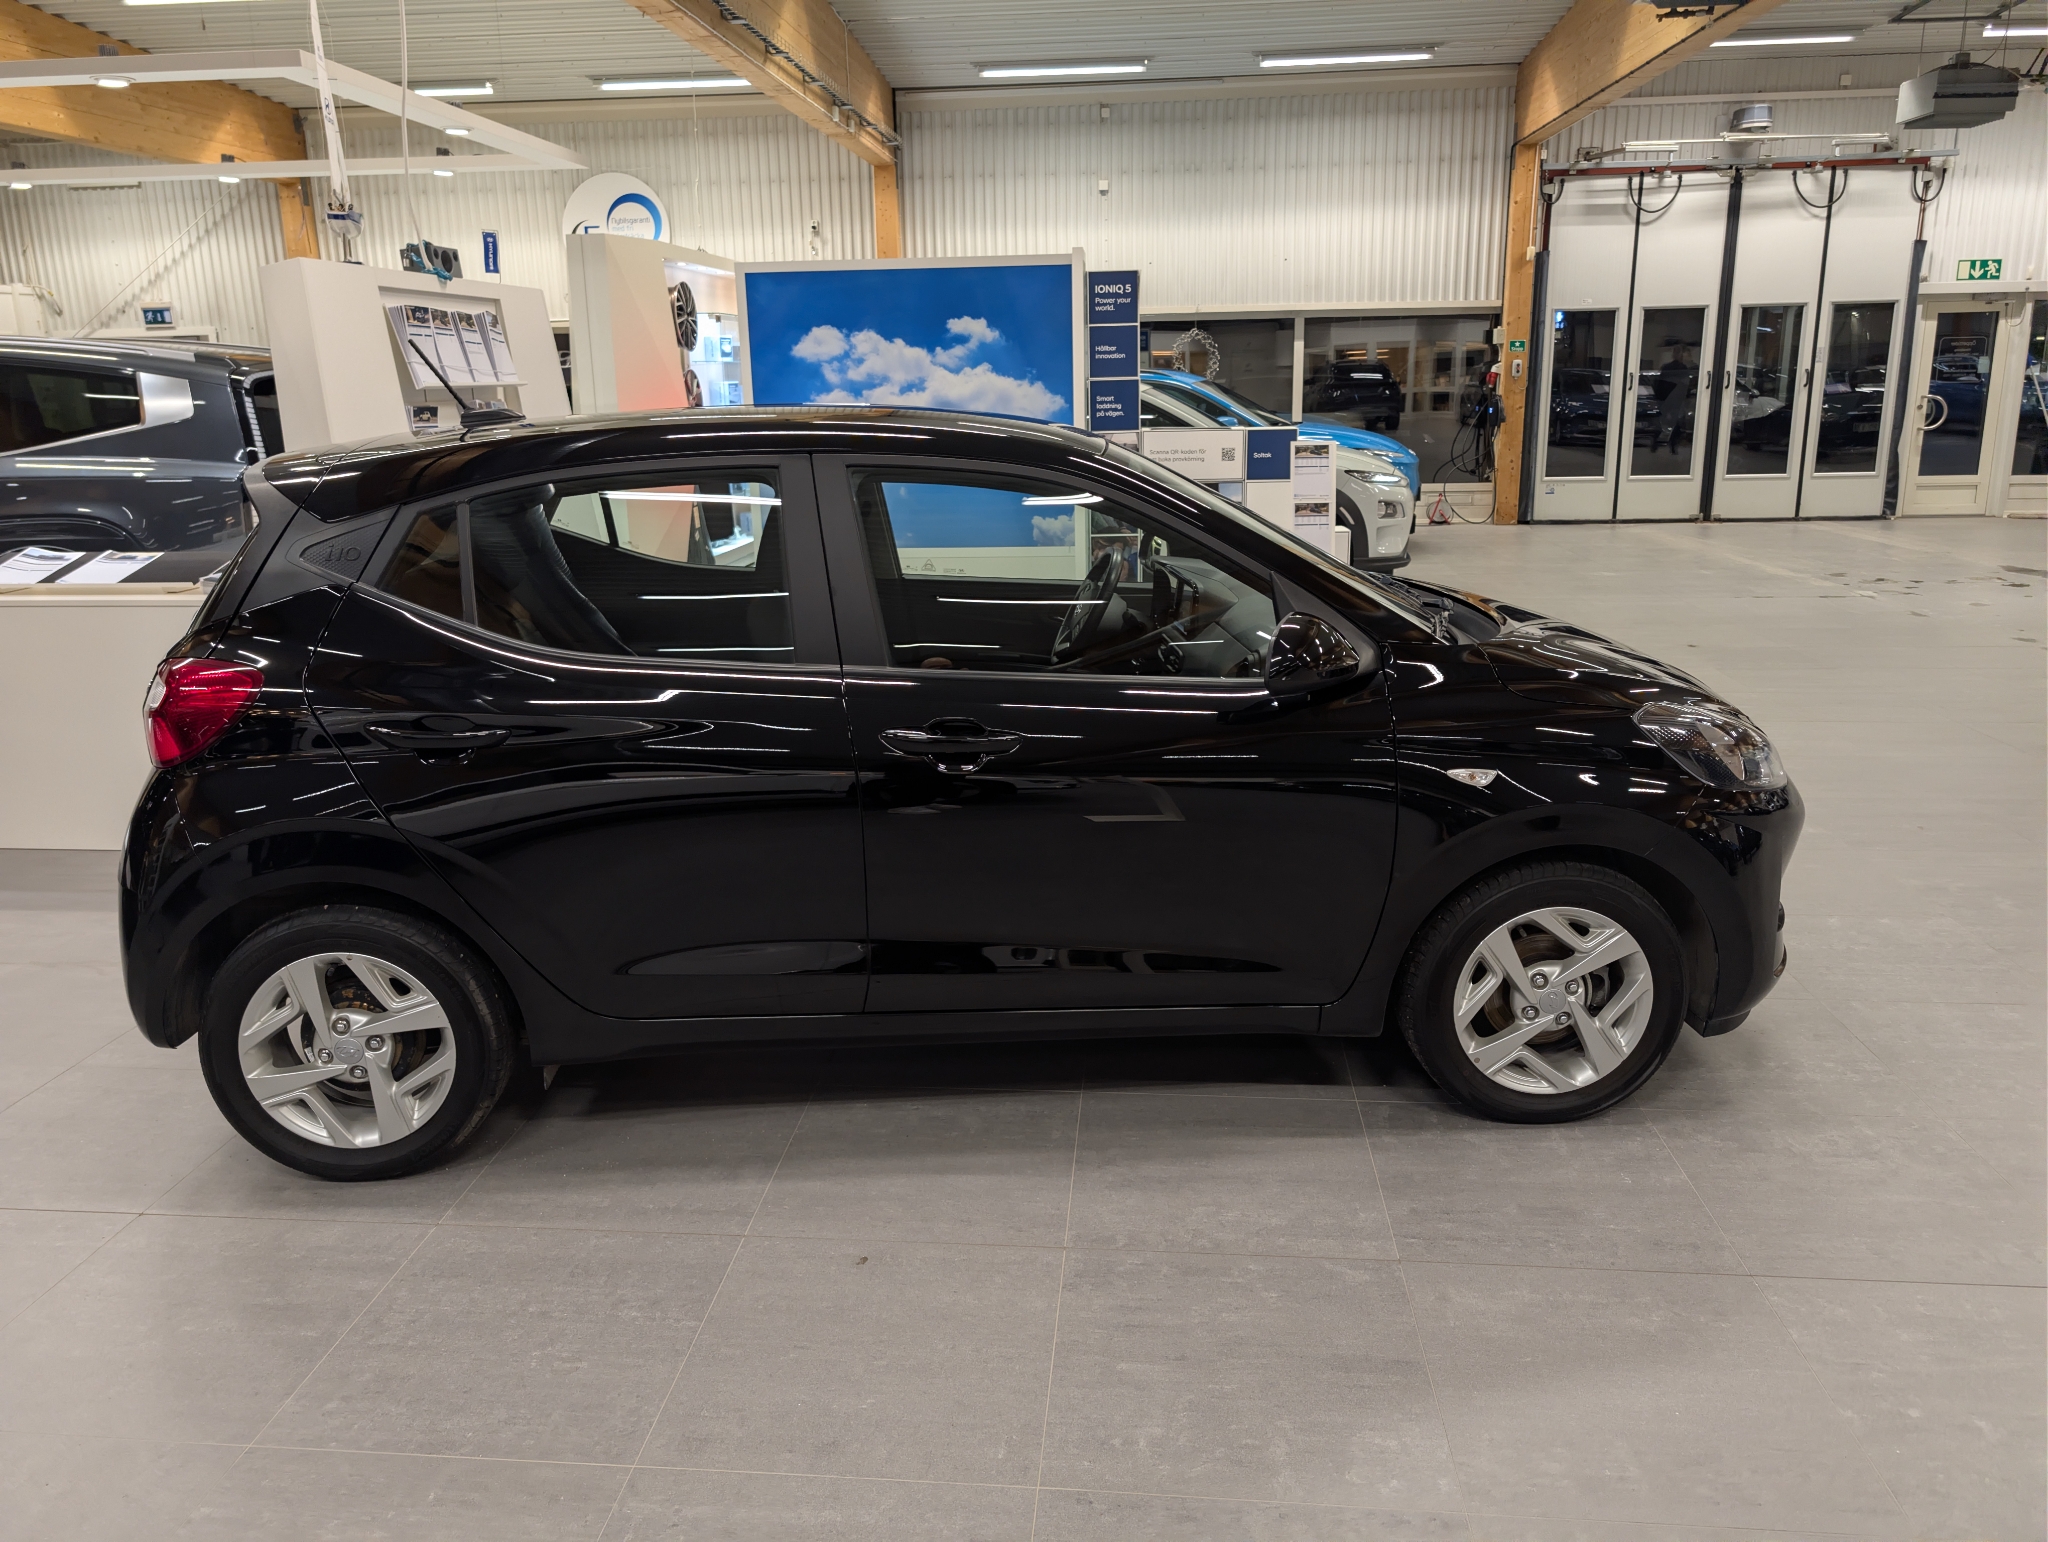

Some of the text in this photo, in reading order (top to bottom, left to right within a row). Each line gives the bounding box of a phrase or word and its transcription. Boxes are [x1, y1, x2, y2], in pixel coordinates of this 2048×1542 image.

[1094, 284, 1132, 294] IONIQ 5
[1253, 451, 1272, 459] Soltak
[325, 544, 362, 562] i10
